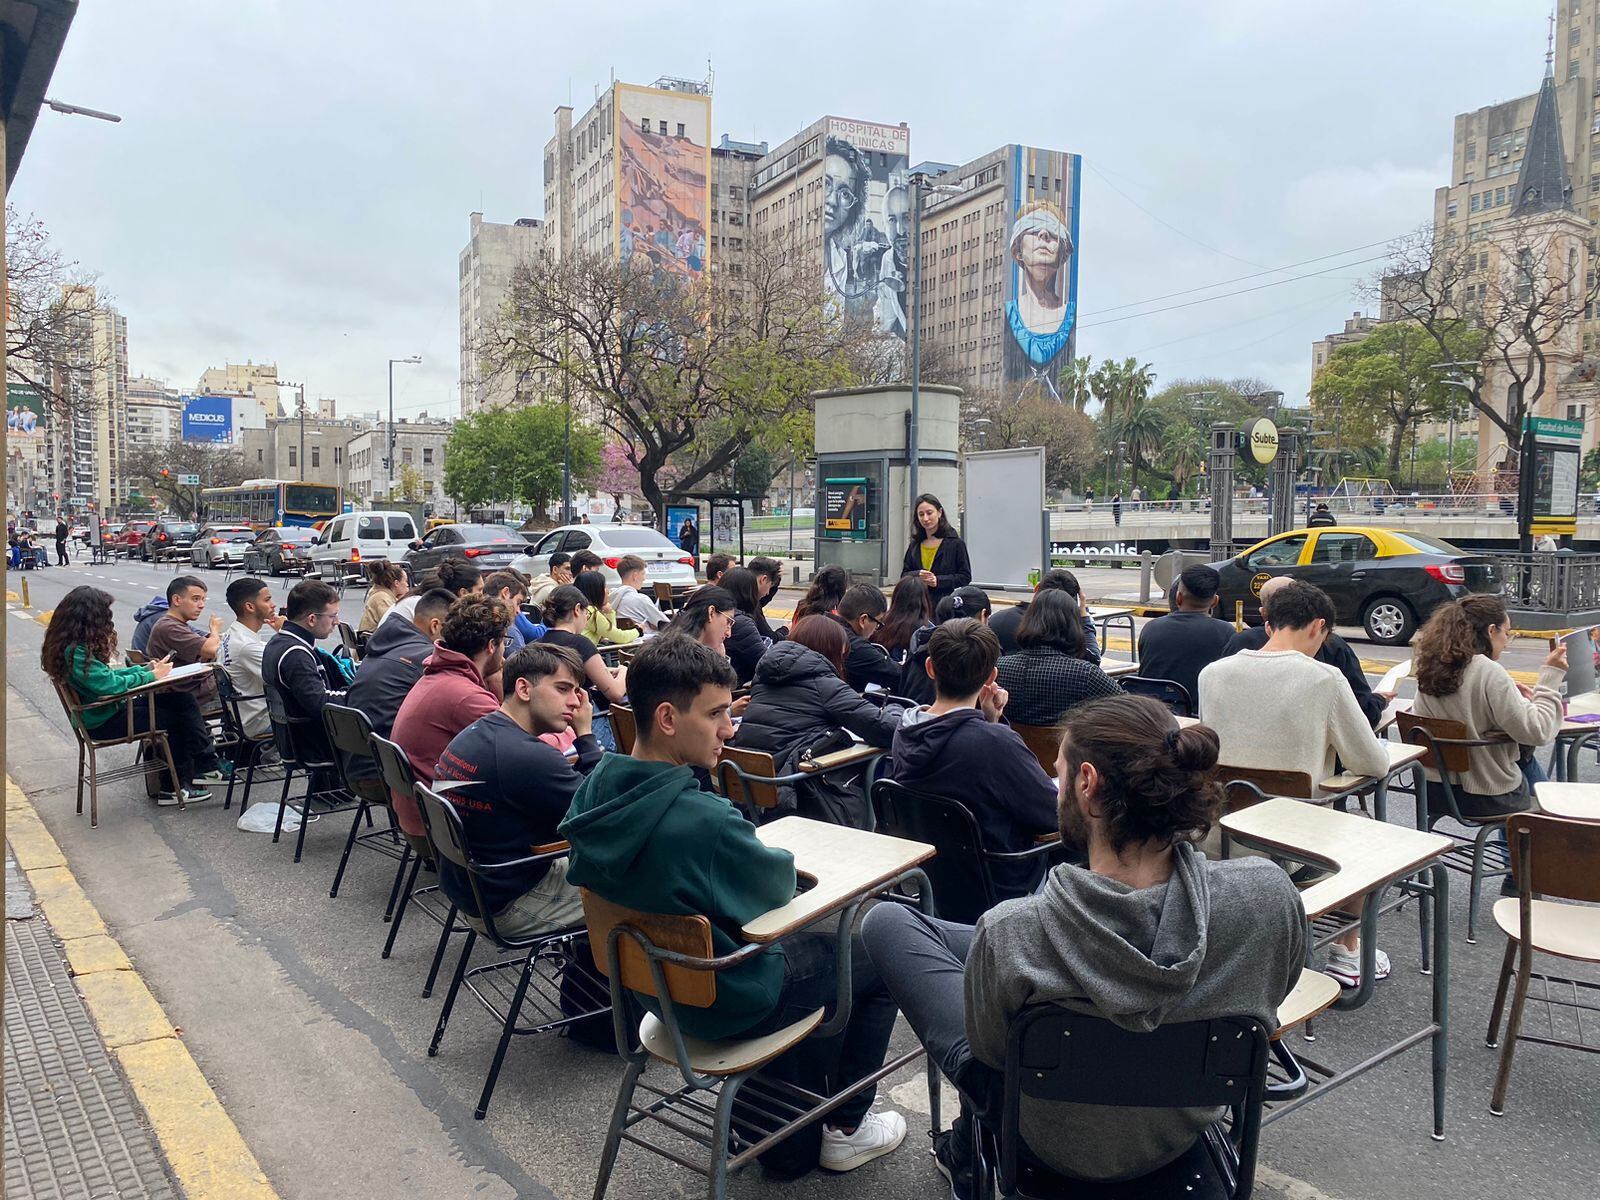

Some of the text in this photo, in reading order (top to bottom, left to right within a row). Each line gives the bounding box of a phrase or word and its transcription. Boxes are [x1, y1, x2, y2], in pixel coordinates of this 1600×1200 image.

[831, 120, 907, 141] HOSPITAL DE
[845, 134, 895, 151] CLINICAS
[189, 413, 225, 422] MEDICUS
[1253, 431, 1278, 444] Subte
[1050, 542, 1137, 564] inépolis
